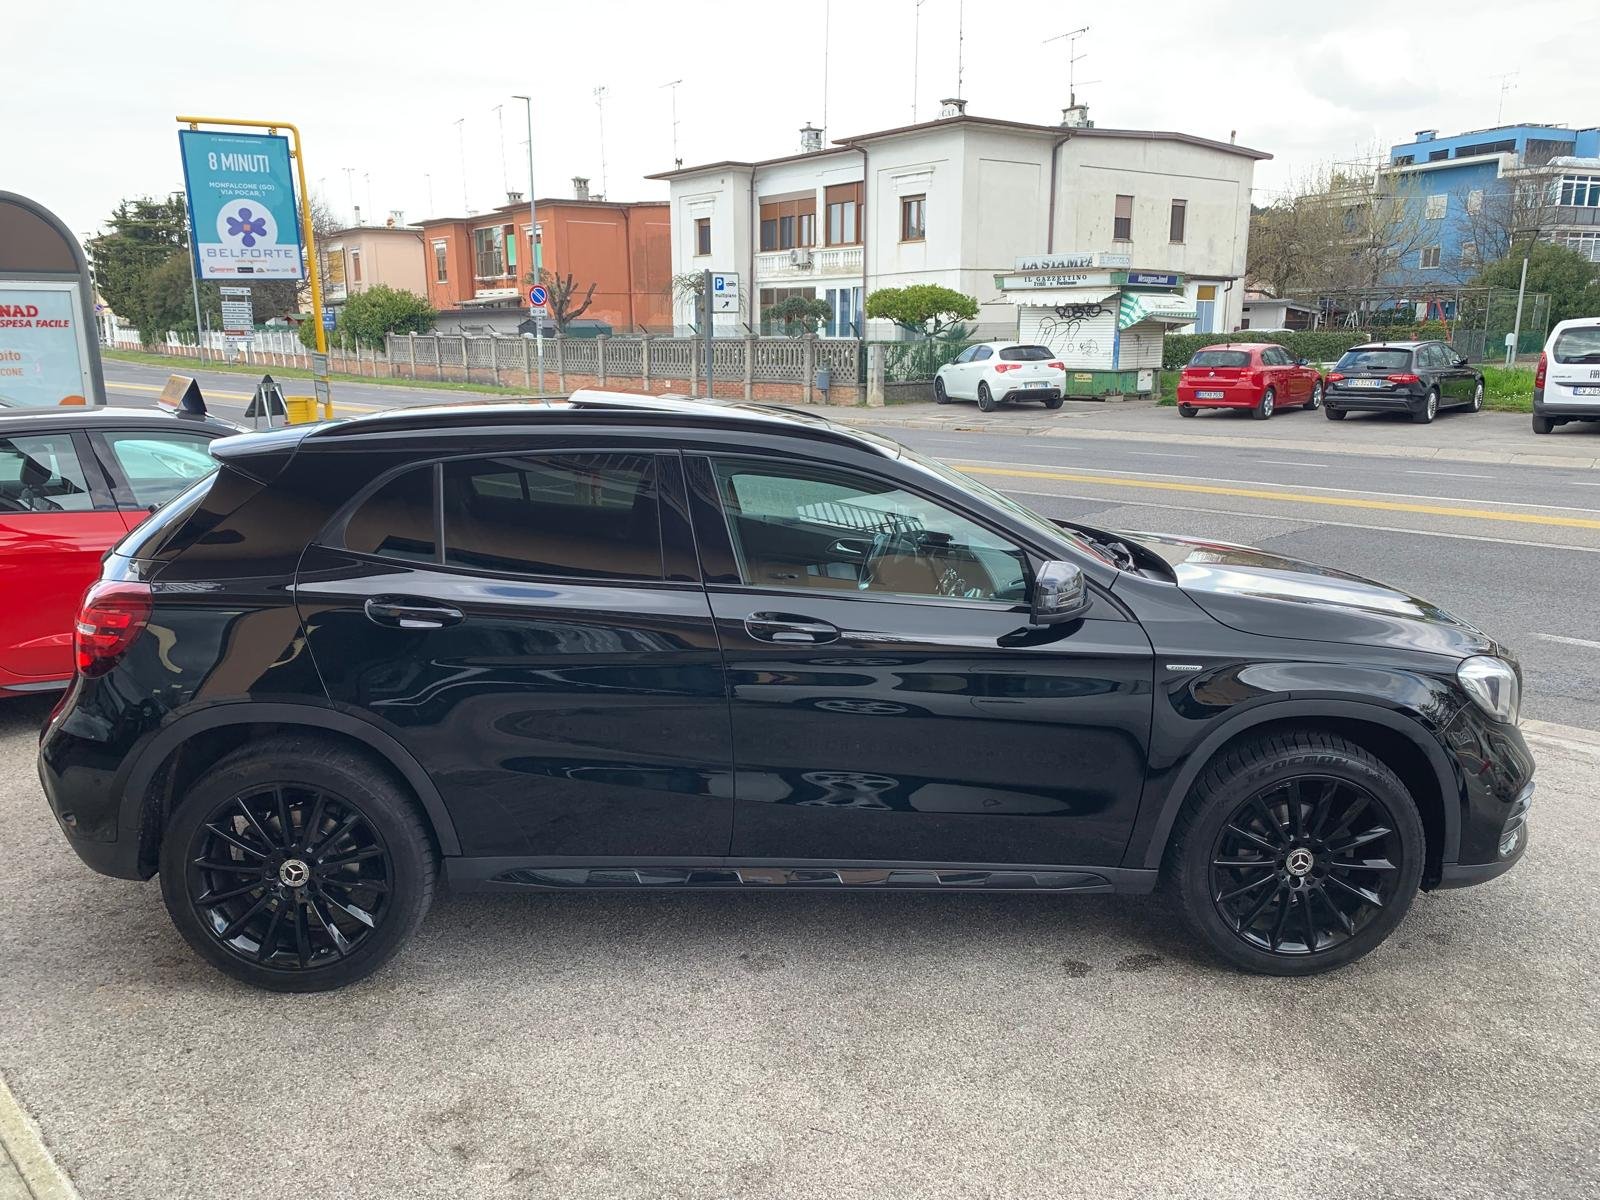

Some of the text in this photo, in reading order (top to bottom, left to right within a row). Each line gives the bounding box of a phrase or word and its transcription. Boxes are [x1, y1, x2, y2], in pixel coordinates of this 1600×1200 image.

[208, 152, 270, 173] 8 MINUTI
[209, 182, 275, 191] MONFALCONE (GO)
[207, 248, 293, 258] BELFORTE
[1021, 256, 1093, 270] LA STAMPA
[0, 319, 70, 328] SPESA FACILE
